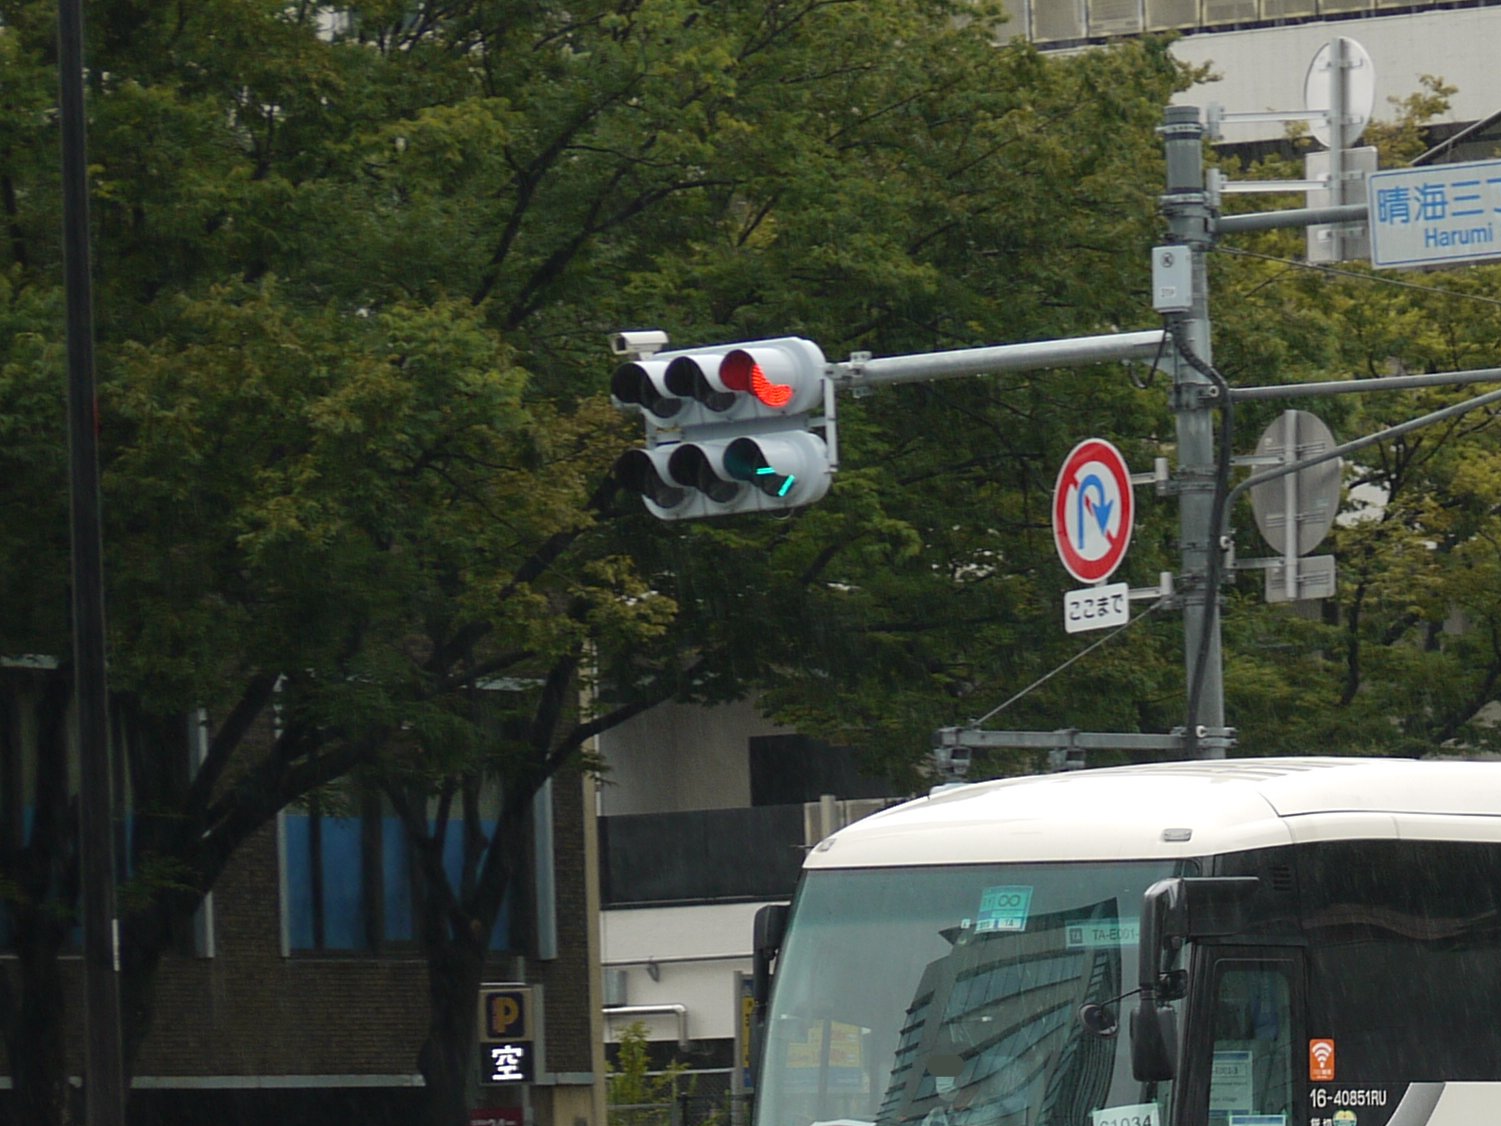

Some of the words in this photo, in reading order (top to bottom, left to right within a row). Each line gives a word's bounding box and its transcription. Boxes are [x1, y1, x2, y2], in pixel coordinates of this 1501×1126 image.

[1423, 221, 1494, 249] Harumi
[1069, 593, 1123, 621] ここまで
[491, 1045, 523, 1081] 空
[1309, 1088, 1387, 1108] 16-40851RU
